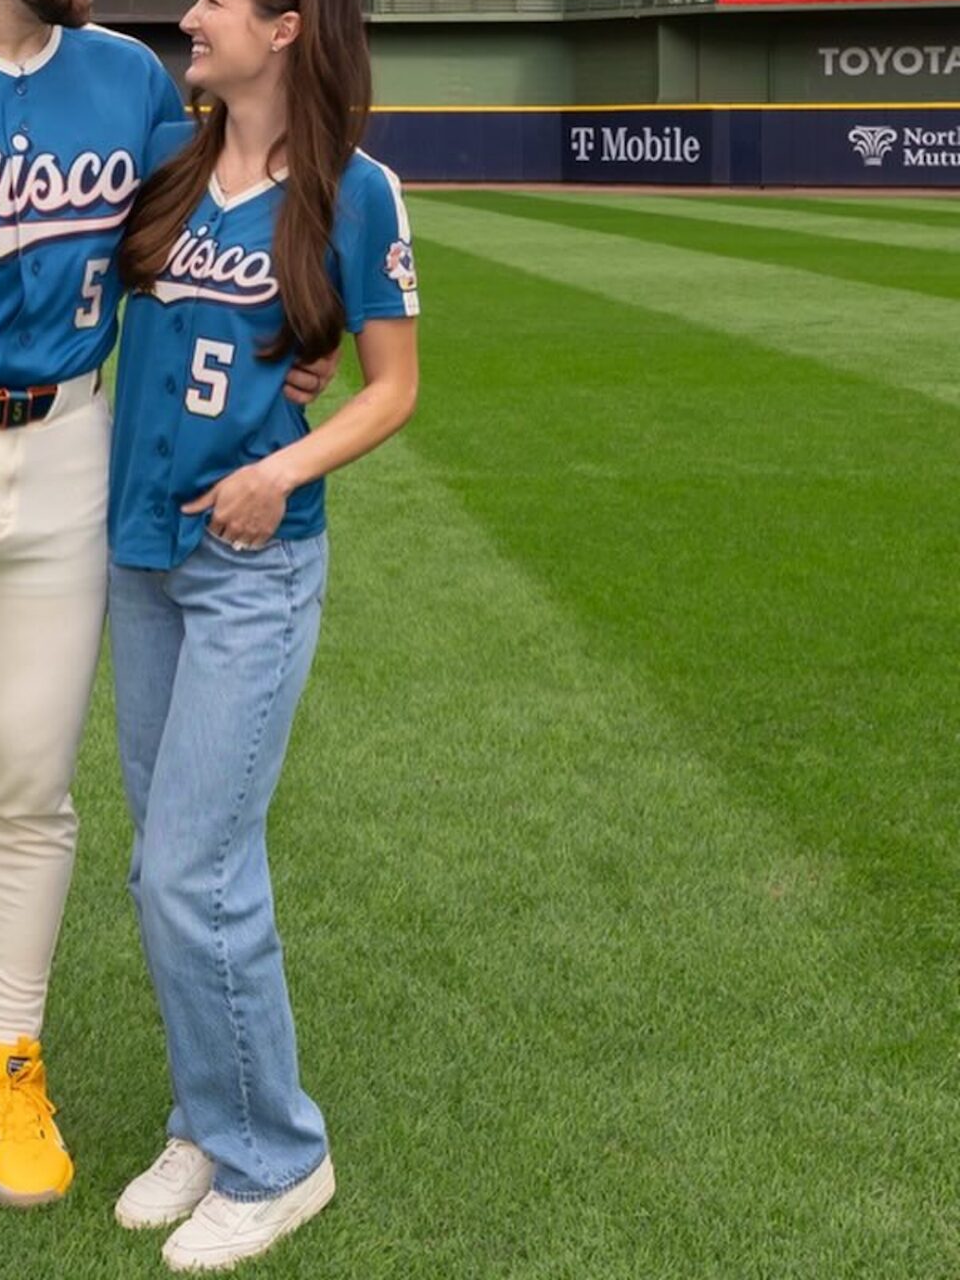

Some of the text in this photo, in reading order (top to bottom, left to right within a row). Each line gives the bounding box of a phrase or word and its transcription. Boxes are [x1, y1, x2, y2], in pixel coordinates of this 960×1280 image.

[601, 126, 700, 163] Mobile
[903, 125, 960, 146] Nort
[158, 226, 279, 290] isco
[75, 258, 109, 328] 5
[185, 338, 234, 417] 5
